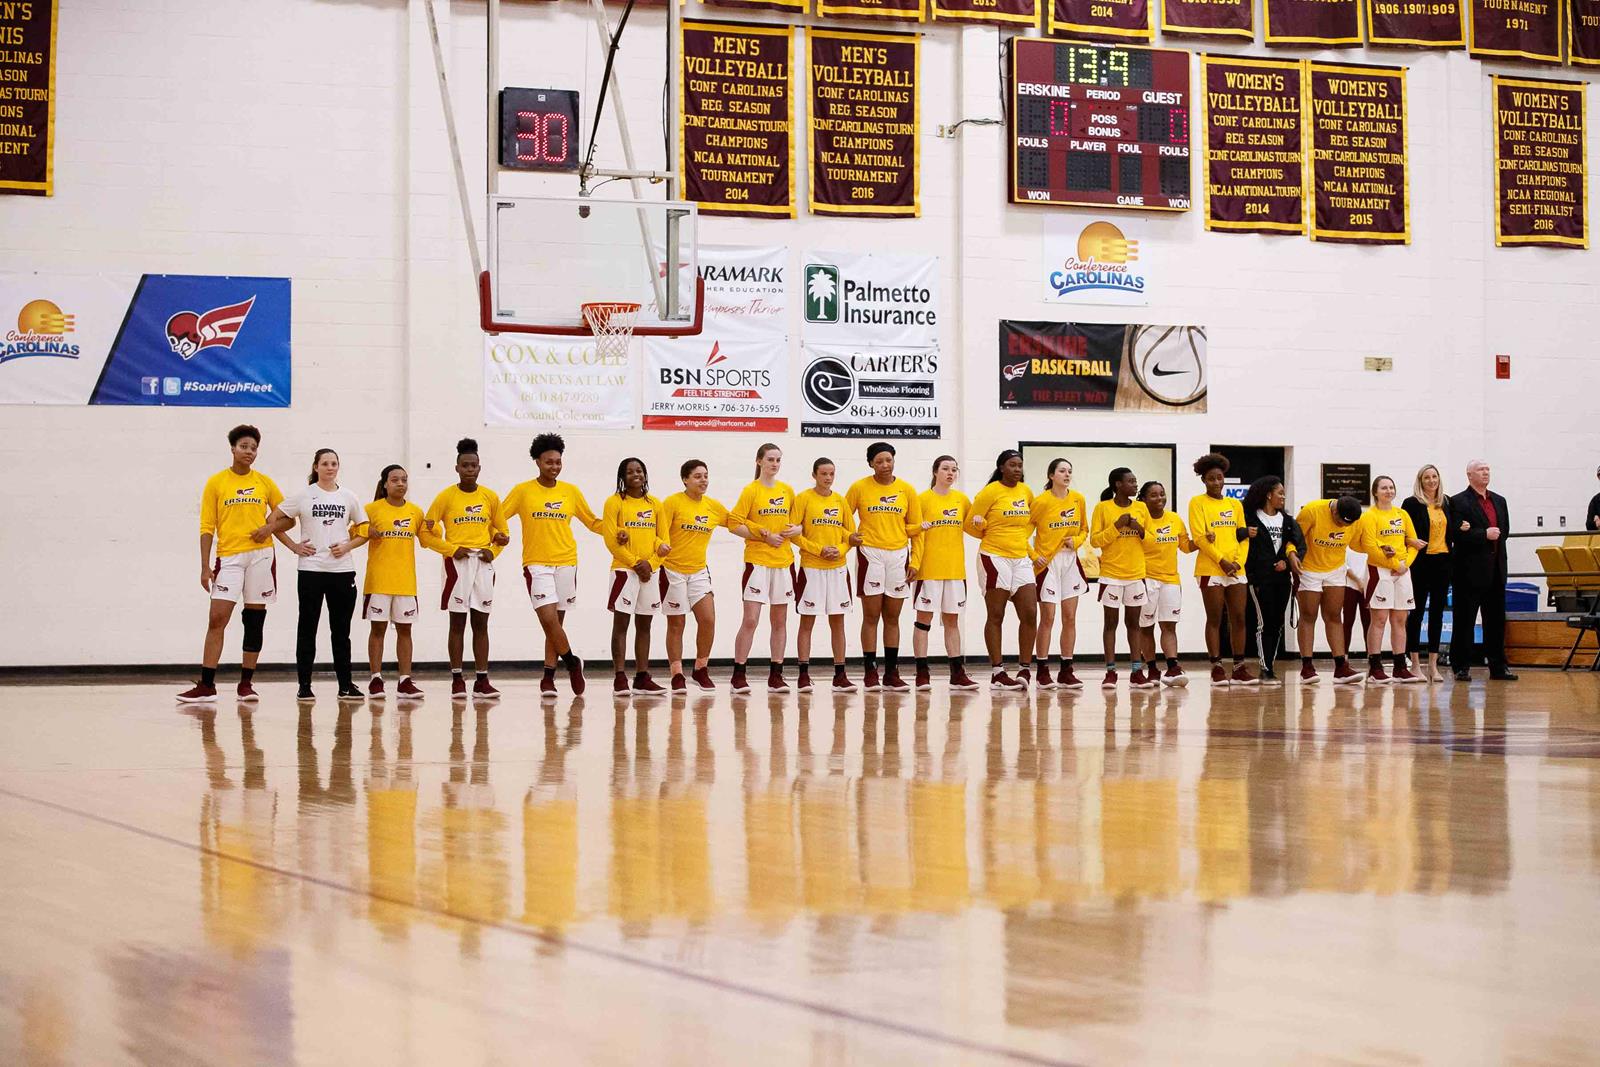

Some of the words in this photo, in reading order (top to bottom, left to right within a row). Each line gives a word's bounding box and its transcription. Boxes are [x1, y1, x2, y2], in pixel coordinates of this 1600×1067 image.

[1091, 5, 1113, 17] 2014
[1507, 18, 1528, 30] 1971
[714, 36, 760, 56] MEN'S
[841, 46, 887, 64] MEN'S
[685, 56, 788, 80] VOLLEYBALL
[814, 65, 913, 88] VOLLEYBALL
[1225, 72, 1284, 91] WOMEN'S
[722, 82, 782, 97] CAROLINAS
[1018, 83, 1070, 98] ERSKINE
[1328, 78, 1387, 98] WOMEN'S
[849, 89, 909, 103] CAROLINAS
[1086, 90, 1120, 101] PERIOD
[1142, 92, 1182, 105] GUEST
[1512, 92, 1568, 110] WOMEN'S
[729, 101, 770, 114] SEASON
[1209, 93, 1299, 112] VOLLEYBALL
[856, 106, 897, 119] SEASON
[1314, 99, 1402, 120] VOLLEYBALL
[708, 117, 758, 131] CAROLINAS
[1092, 114, 1118, 124] POSS
[1242, 117, 1296, 129] CAROLINAS
[1500, 110, 1581, 130] VOLLEYBALL
[836, 120, 883, 134] CAROLINAS
[1088, 127, 1121, 137] BONUS
[1346, 121, 1397, 134] CAROLINAS
[517, 112, 567, 162] 30
[706, 134, 768, 149] CHAMPIONS
[833, 137, 894, 150] CHAMPIONS
[1018, 138, 1048, 148] FOULS
[1248, 134, 1284, 145] SEASON
[1352, 136, 1387, 148] SEASON
[1530, 131, 1578, 145] CAROLINAS
[1070, 141, 1106, 151] PLAYER
[1118, 143, 1142, 153] FOUL
[1159, 146, 1188, 156] FOULS
[1535, 146, 1568, 158] SEASON
[694, 151, 722, 164] NCAA
[727, 154, 780, 167] NATIONAL
[821, 152, 850, 164] NCAA
[854, 154, 905, 167] NATIONAL
[1230, 150, 1274, 162] CAROLINAS
[1335, 151, 1378, 163] CAROLINAS
[1334, 166, 1385, 179] CHAMPIONS
[1519, 160, 1558, 173] CAROLINAS
[700, 169, 774, 184] TOURNAMENT
[827, 168, 898, 184] TOURNAMENT
[1231, 168, 1283, 180] CHAMPIONS
[1517, 174, 1566, 187] CHAMPIONS
[726, 188, 748, 200] 2014
[852, 187, 874, 199] 2016
[1210, 184, 1232, 196] NCAA
[1234, 186, 1276, 197] NATIONAL
[1324, 181, 1348, 192] NCAA
[1352, 182, 1396, 195] NATIONAL
[1028, 191, 1050, 200] WON
[1117, 196, 1144, 206] GAME
[1507, 189, 1531, 200] NCAA
[1534, 190, 1576, 203] REGIONAL
[1168, 199, 1190, 208] WON
[1245, 203, 1270, 214] 2014
[1330, 196, 1390, 210] TOURNAMENT
[1510, 204, 1574, 216] SEMI-FINALIST
[1350, 214, 1373, 225] 2015
[1534, 219, 1554, 230] 2016
[1065, 257, 1127, 274] Conference
[1050, 271, 1144, 290] CAROLINAS
[730, 286, 784, 294] EDUCATION
[844, 280, 930, 303] Palmetto
[844, 302, 936, 325] Insurance
[6, 329, 64, 344] Conference
[491, 344, 539, 364] COX
[546, 346, 560, 365] &
[850, 352, 938, 374] CARTER'S
[1031, 358, 1112, 376] BASKETBALL
[660, 368, 701, 385] BSN
[706, 368, 770, 387] SPORTS
[184, 382, 272, 393] #SoarHighFleet
[863, 385, 899, 394] Wholesale
[901, 386, 930, 396] Flooring
[651, 402, 675, 411] JERRY
[678, 403, 710, 411] MORRIS
[720, 404, 780, 413] 706-376-5595
[822, 427, 849, 435] Highway
[312, 504, 346, 512] ALWAYS
